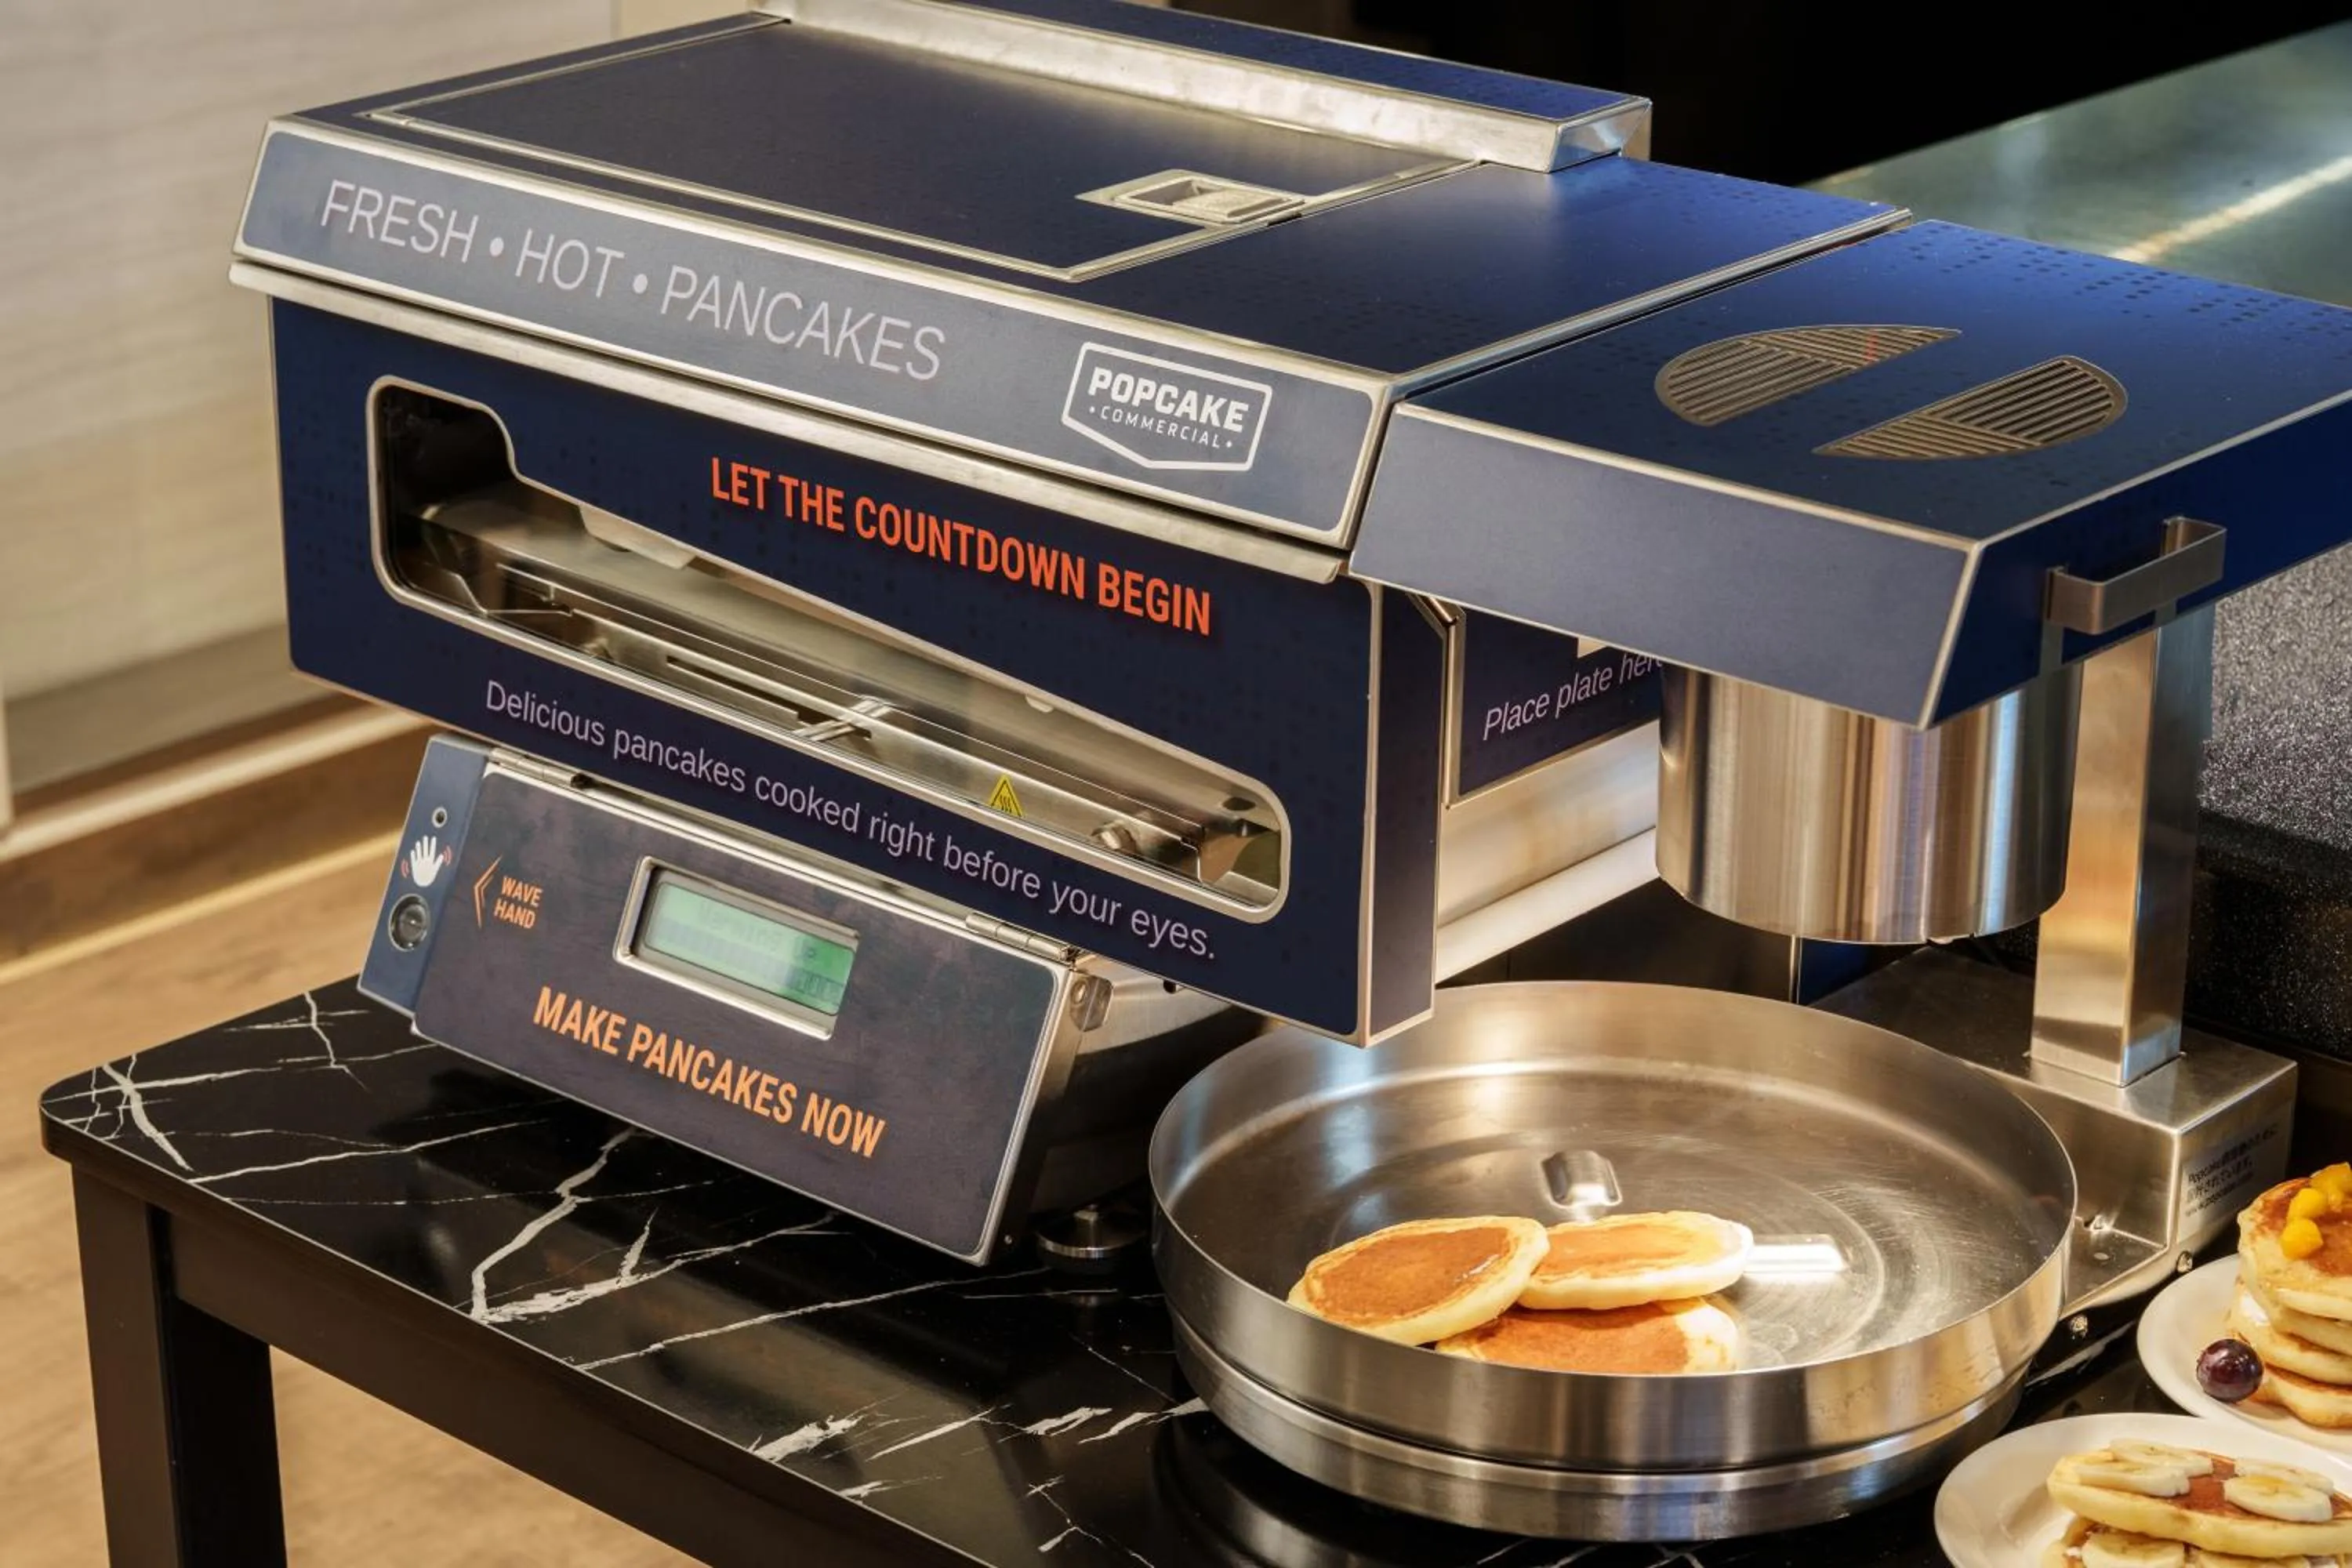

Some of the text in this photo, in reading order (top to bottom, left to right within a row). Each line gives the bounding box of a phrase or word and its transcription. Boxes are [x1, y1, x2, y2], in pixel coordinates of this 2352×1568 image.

[321, 180, 946, 380] FRESH HOT PANCAKES
[1087, 366, 1250, 433] POPCAKE
[1100, 405, 1221, 449] COMMERCIAL
[712, 456, 1210, 636] LET THE COUNTDOWN BEGIN
[1483, 692, 1551, 741] Place
[1555, 664, 1613, 720] plate
[486, 680, 1216, 959] Delicious pancakes cooked right before your eyes.
[493, 898, 536, 930] HAND
[501, 874, 544, 908] WAVE
[532, 985, 886, 1159] MAKE PANCAKES NOW
